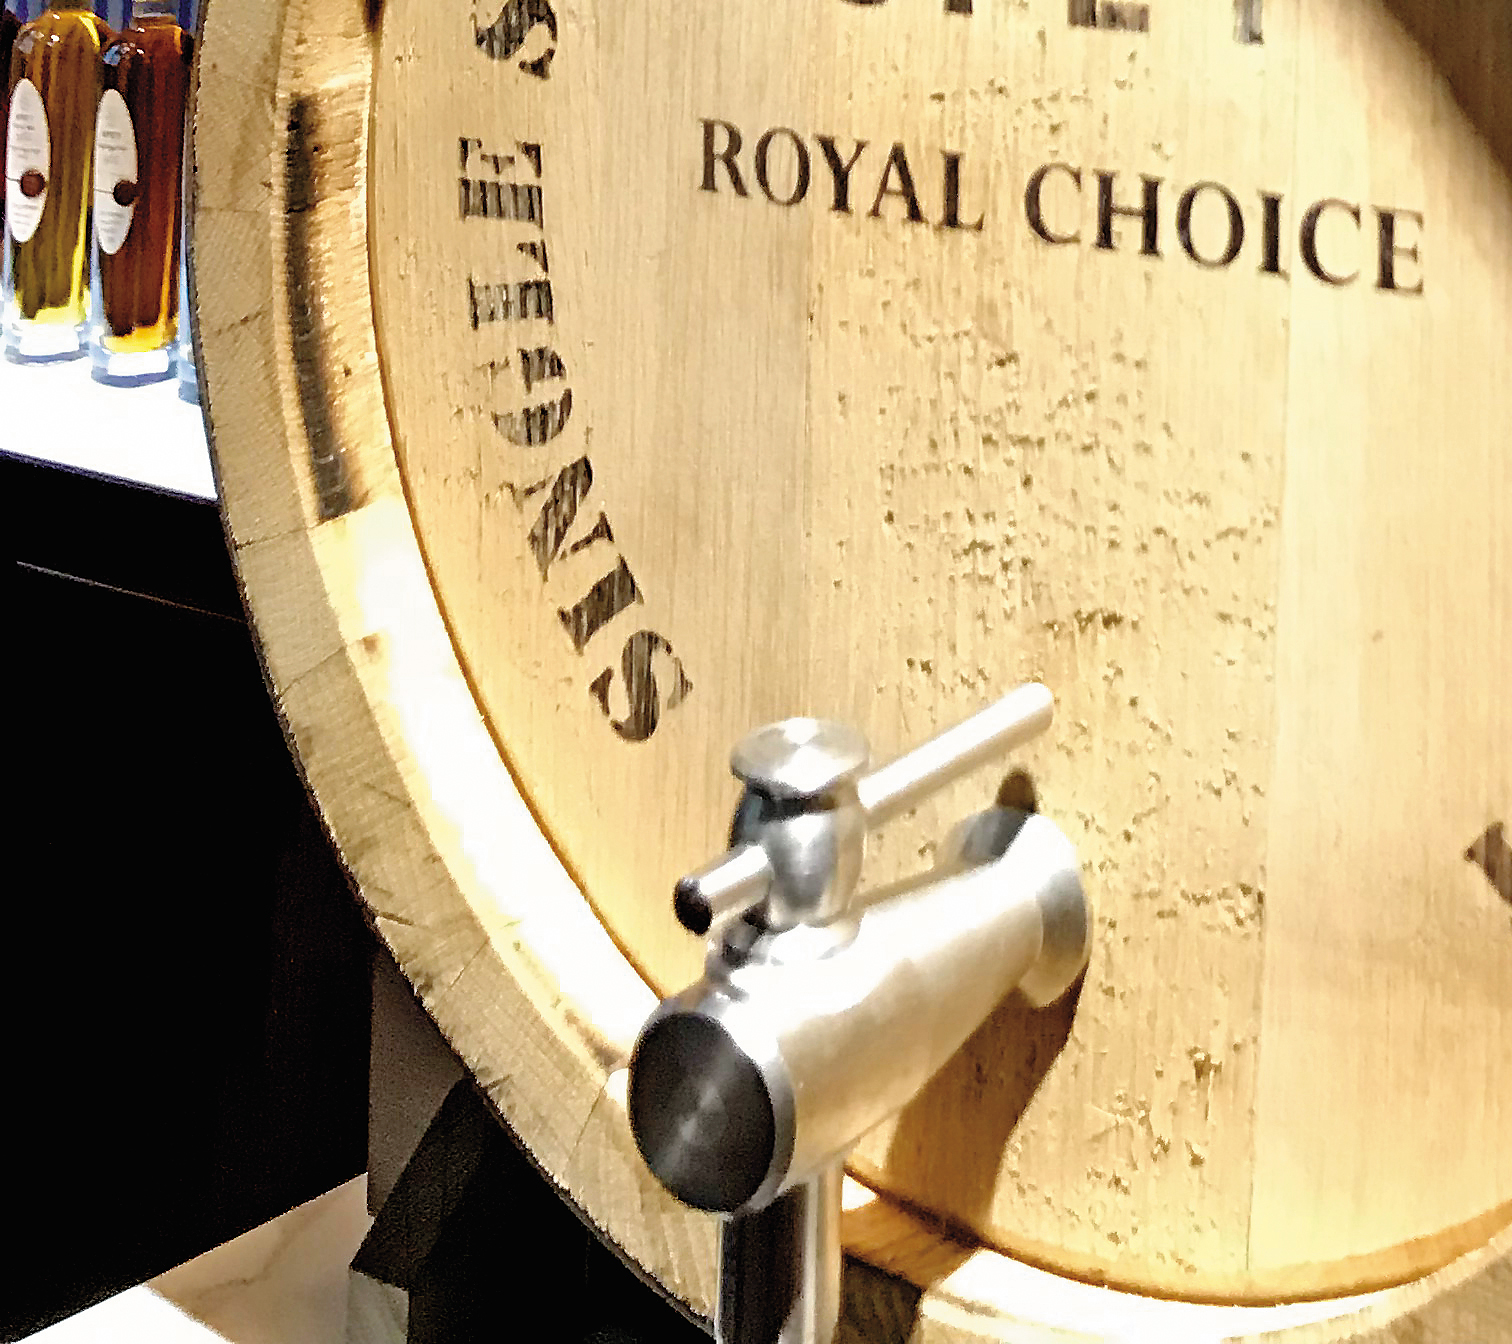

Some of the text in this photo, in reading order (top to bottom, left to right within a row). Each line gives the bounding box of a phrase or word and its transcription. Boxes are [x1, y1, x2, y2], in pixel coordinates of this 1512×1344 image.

[698, 117, 1427, 297] ROYAL CHOICE
[458, 136, 694, 744] SINGLE
